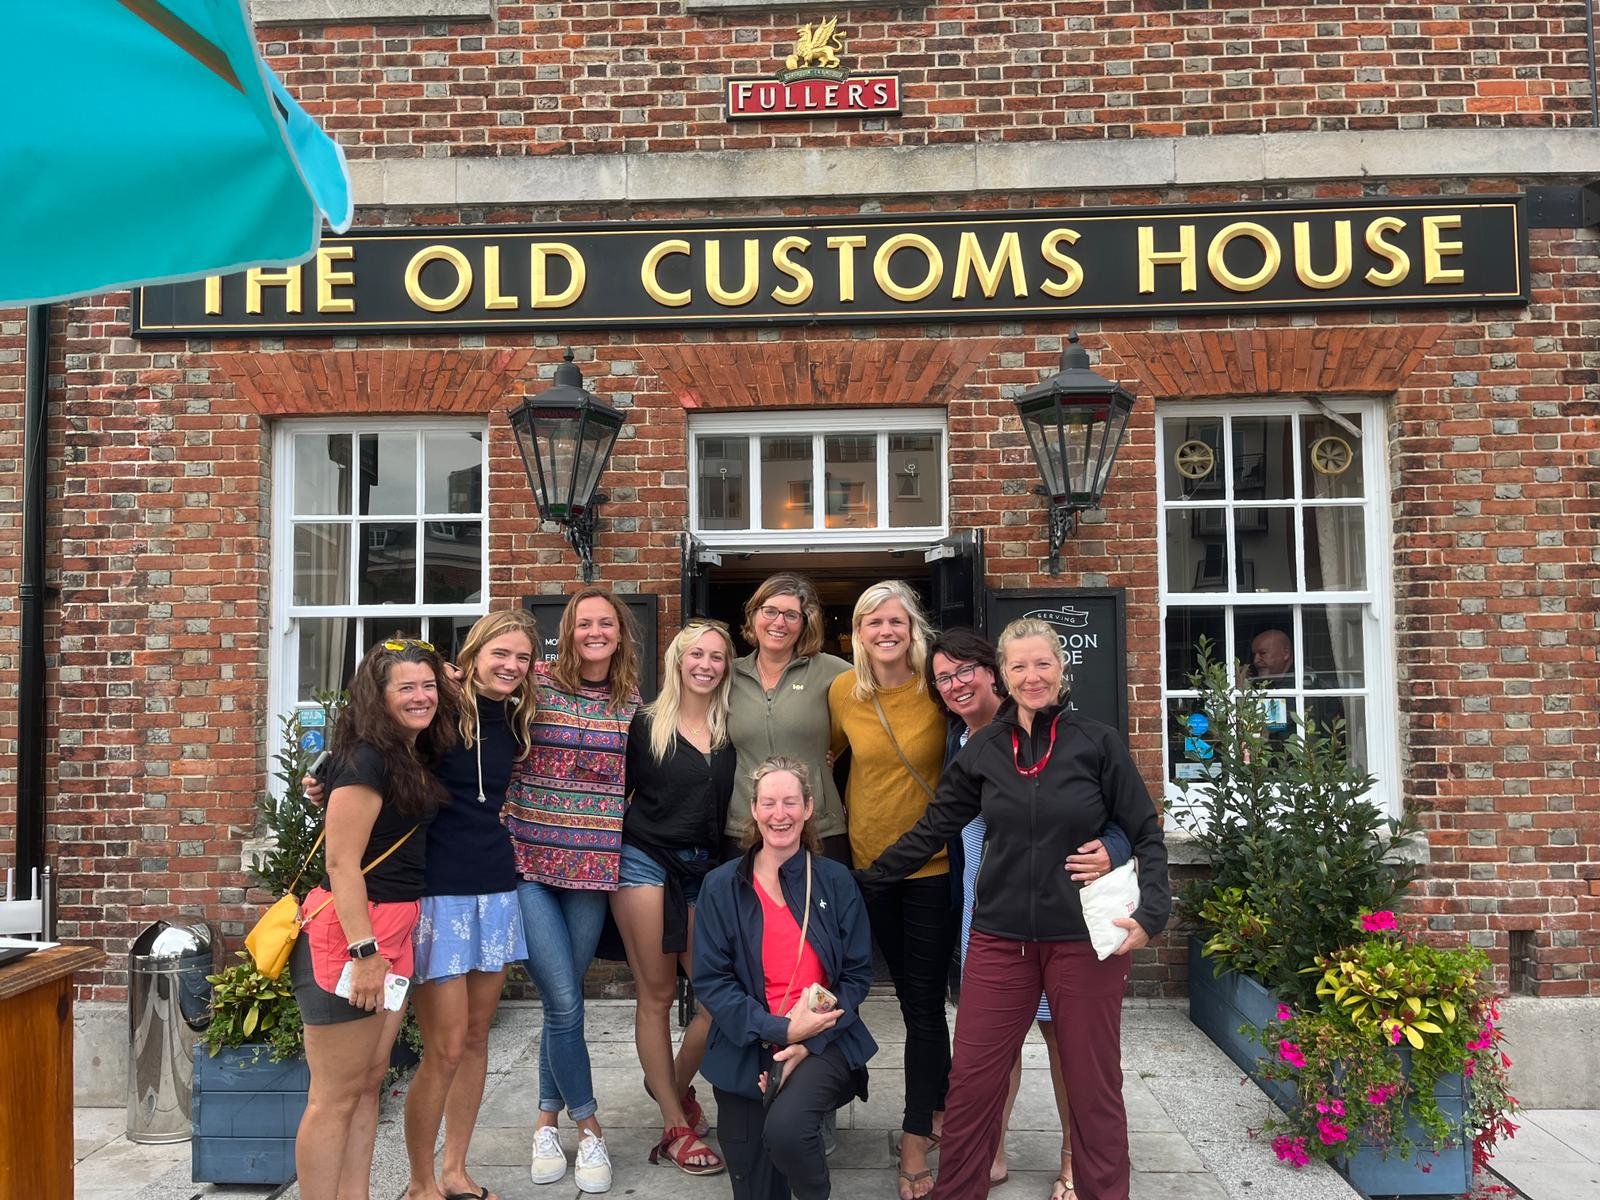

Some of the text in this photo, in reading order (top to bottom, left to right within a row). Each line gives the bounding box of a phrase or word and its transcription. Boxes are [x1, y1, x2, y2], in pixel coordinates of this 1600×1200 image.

[738, 81, 889, 110] FULLER'S
[404, 242, 587, 312] OLD
[641, 228, 1084, 307] CUSTOMS
[1138, 215, 1465, 294] HOUSE
[1037, 613, 1076, 624] SERVING
